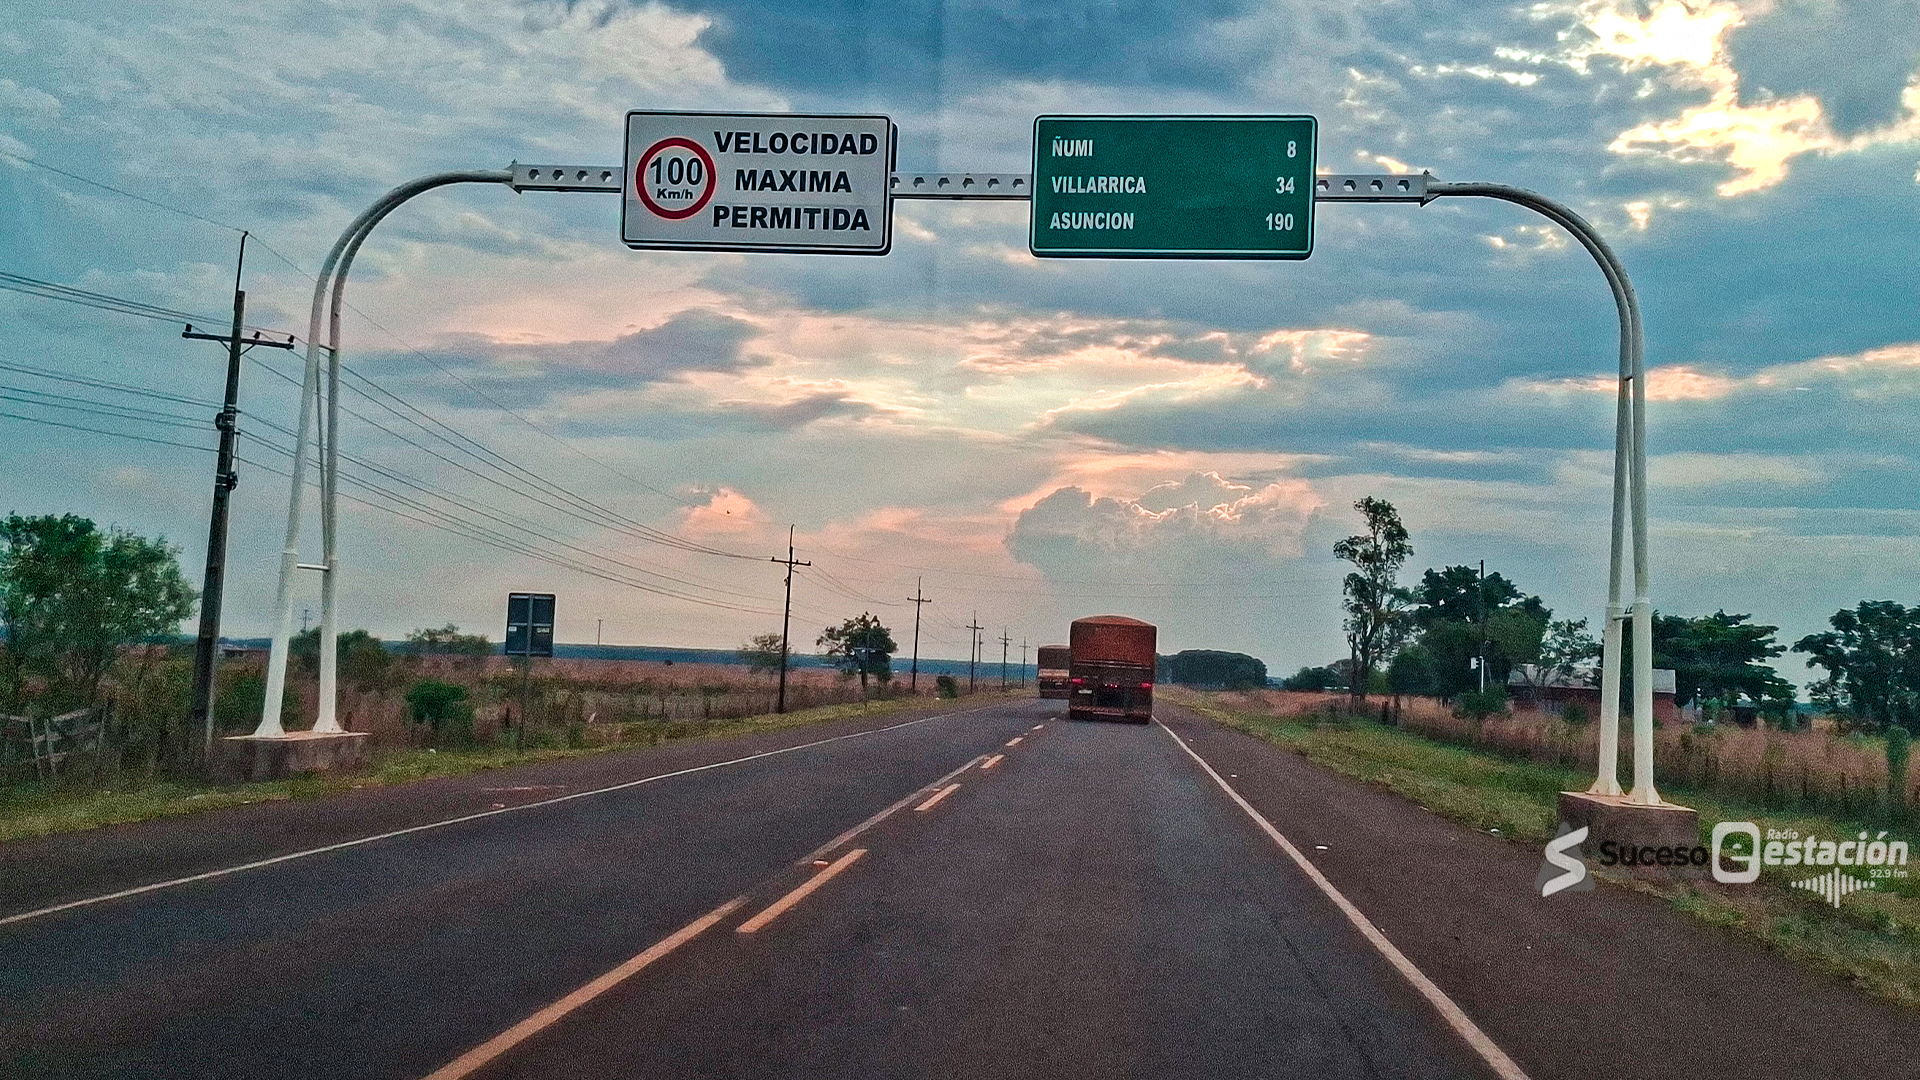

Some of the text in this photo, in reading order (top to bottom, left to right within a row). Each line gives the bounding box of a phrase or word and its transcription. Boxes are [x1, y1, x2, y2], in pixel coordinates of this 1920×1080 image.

[714, 131, 878, 155] VELOCIDAD
[1052, 135, 1297, 158] ÑUMI 8
[650, 157, 703, 186] 100
[735, 169, 852, 193] MAXIMA
[656, 188, 694, 200] Km/h
[1051, 176, 1295, 195] VILLARRICA 34
[713, 205, 871, 231] PERMITIDA
[1049, 212, 1294, 231] ASUNCION 190
